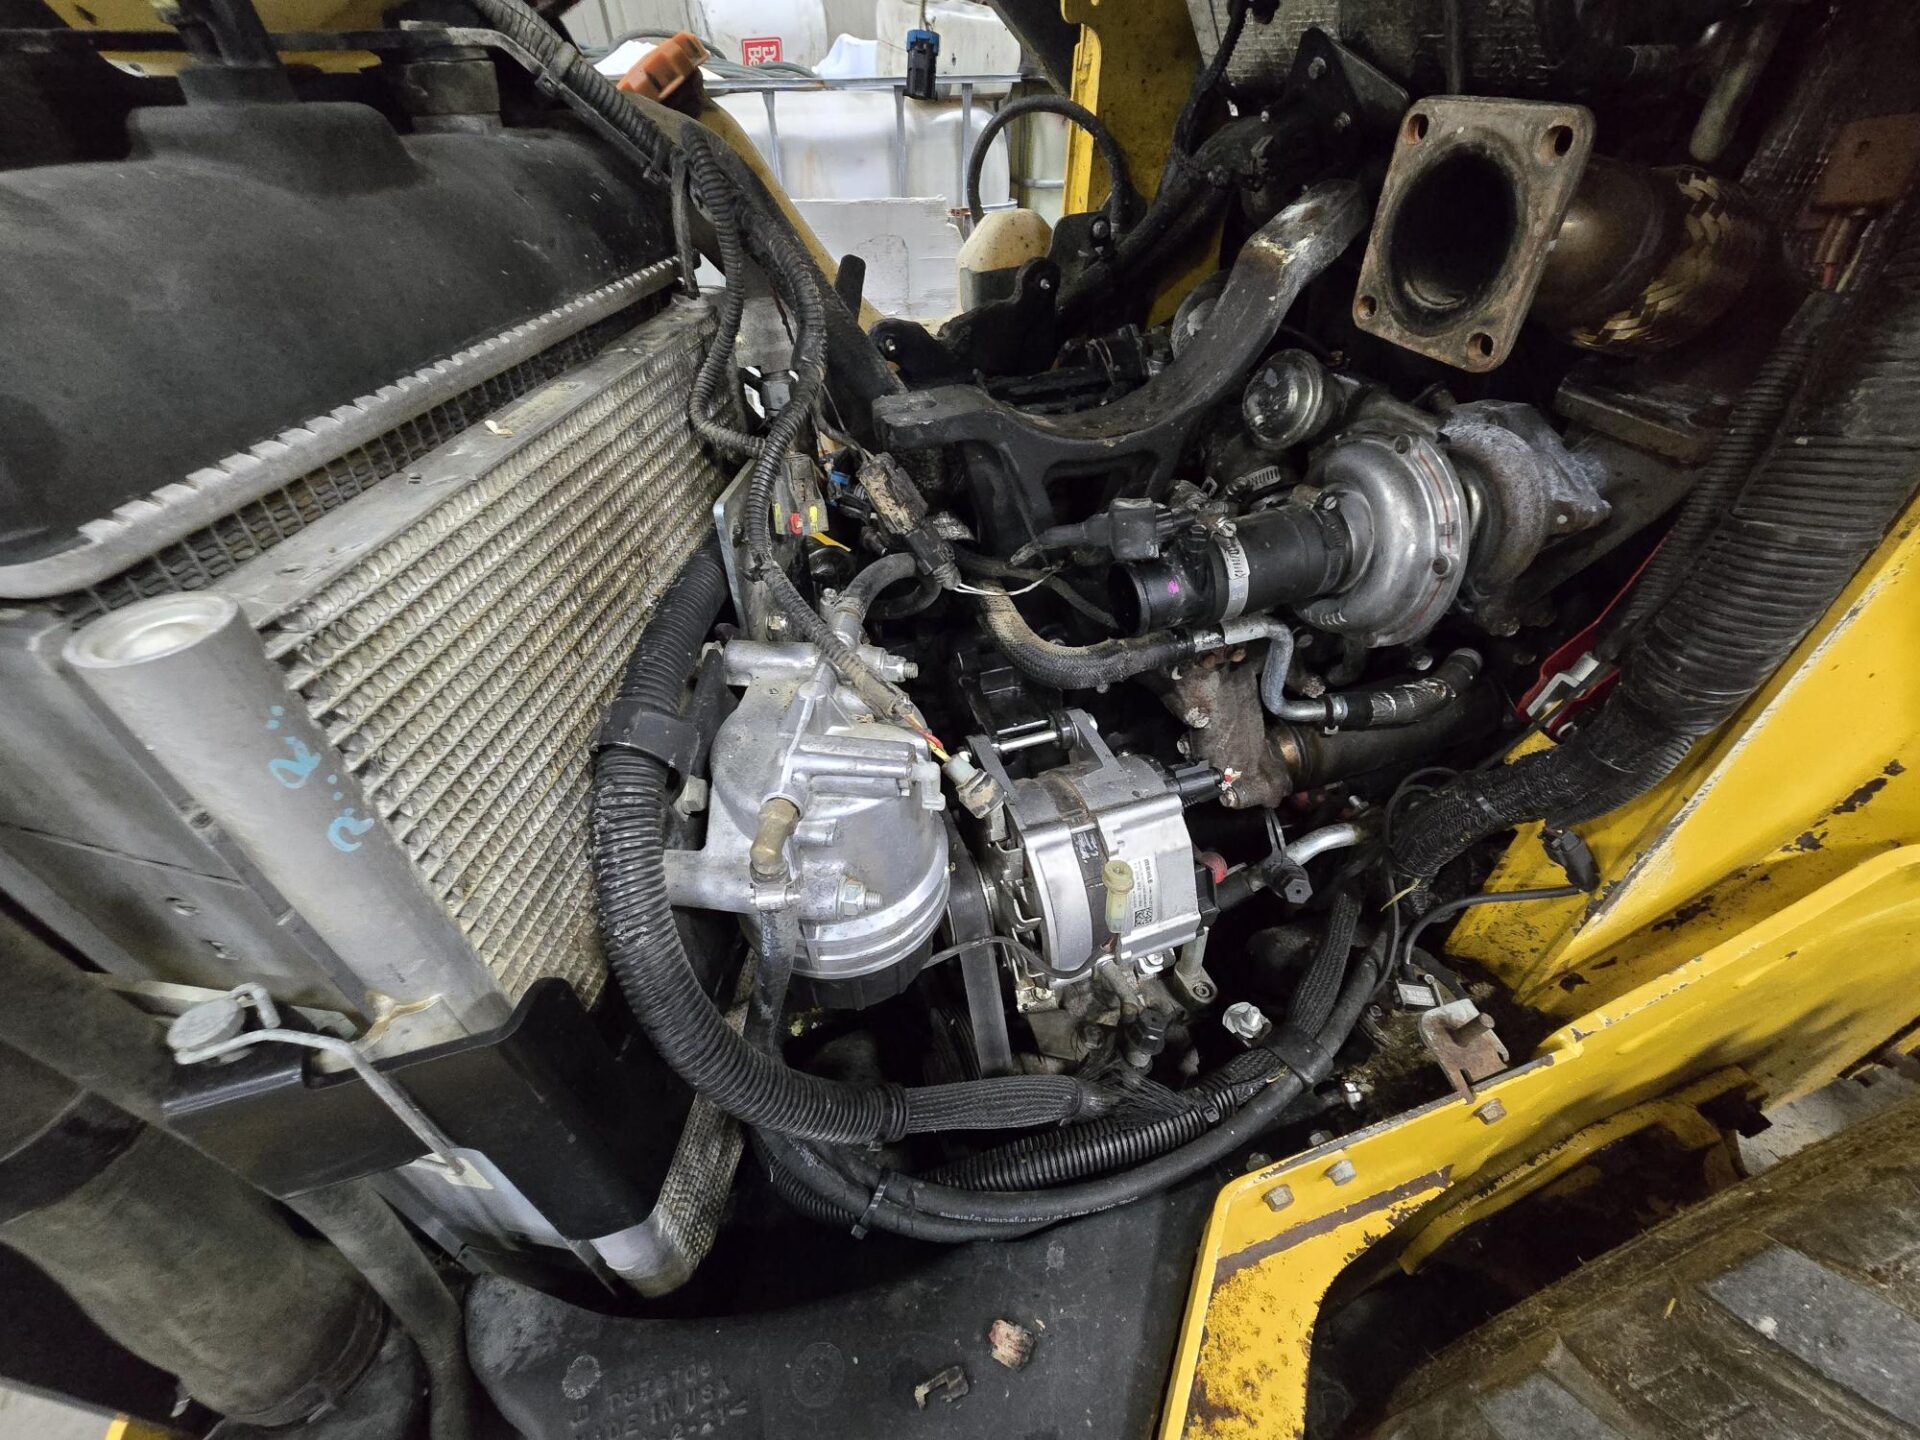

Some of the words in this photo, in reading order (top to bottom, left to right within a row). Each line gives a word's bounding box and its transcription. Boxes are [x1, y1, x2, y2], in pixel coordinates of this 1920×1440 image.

[940, 1210, 982, 1222] Systems
[984, 1215, 1026, 1223] Injection
[684, 1379, 732, 1414] USA
